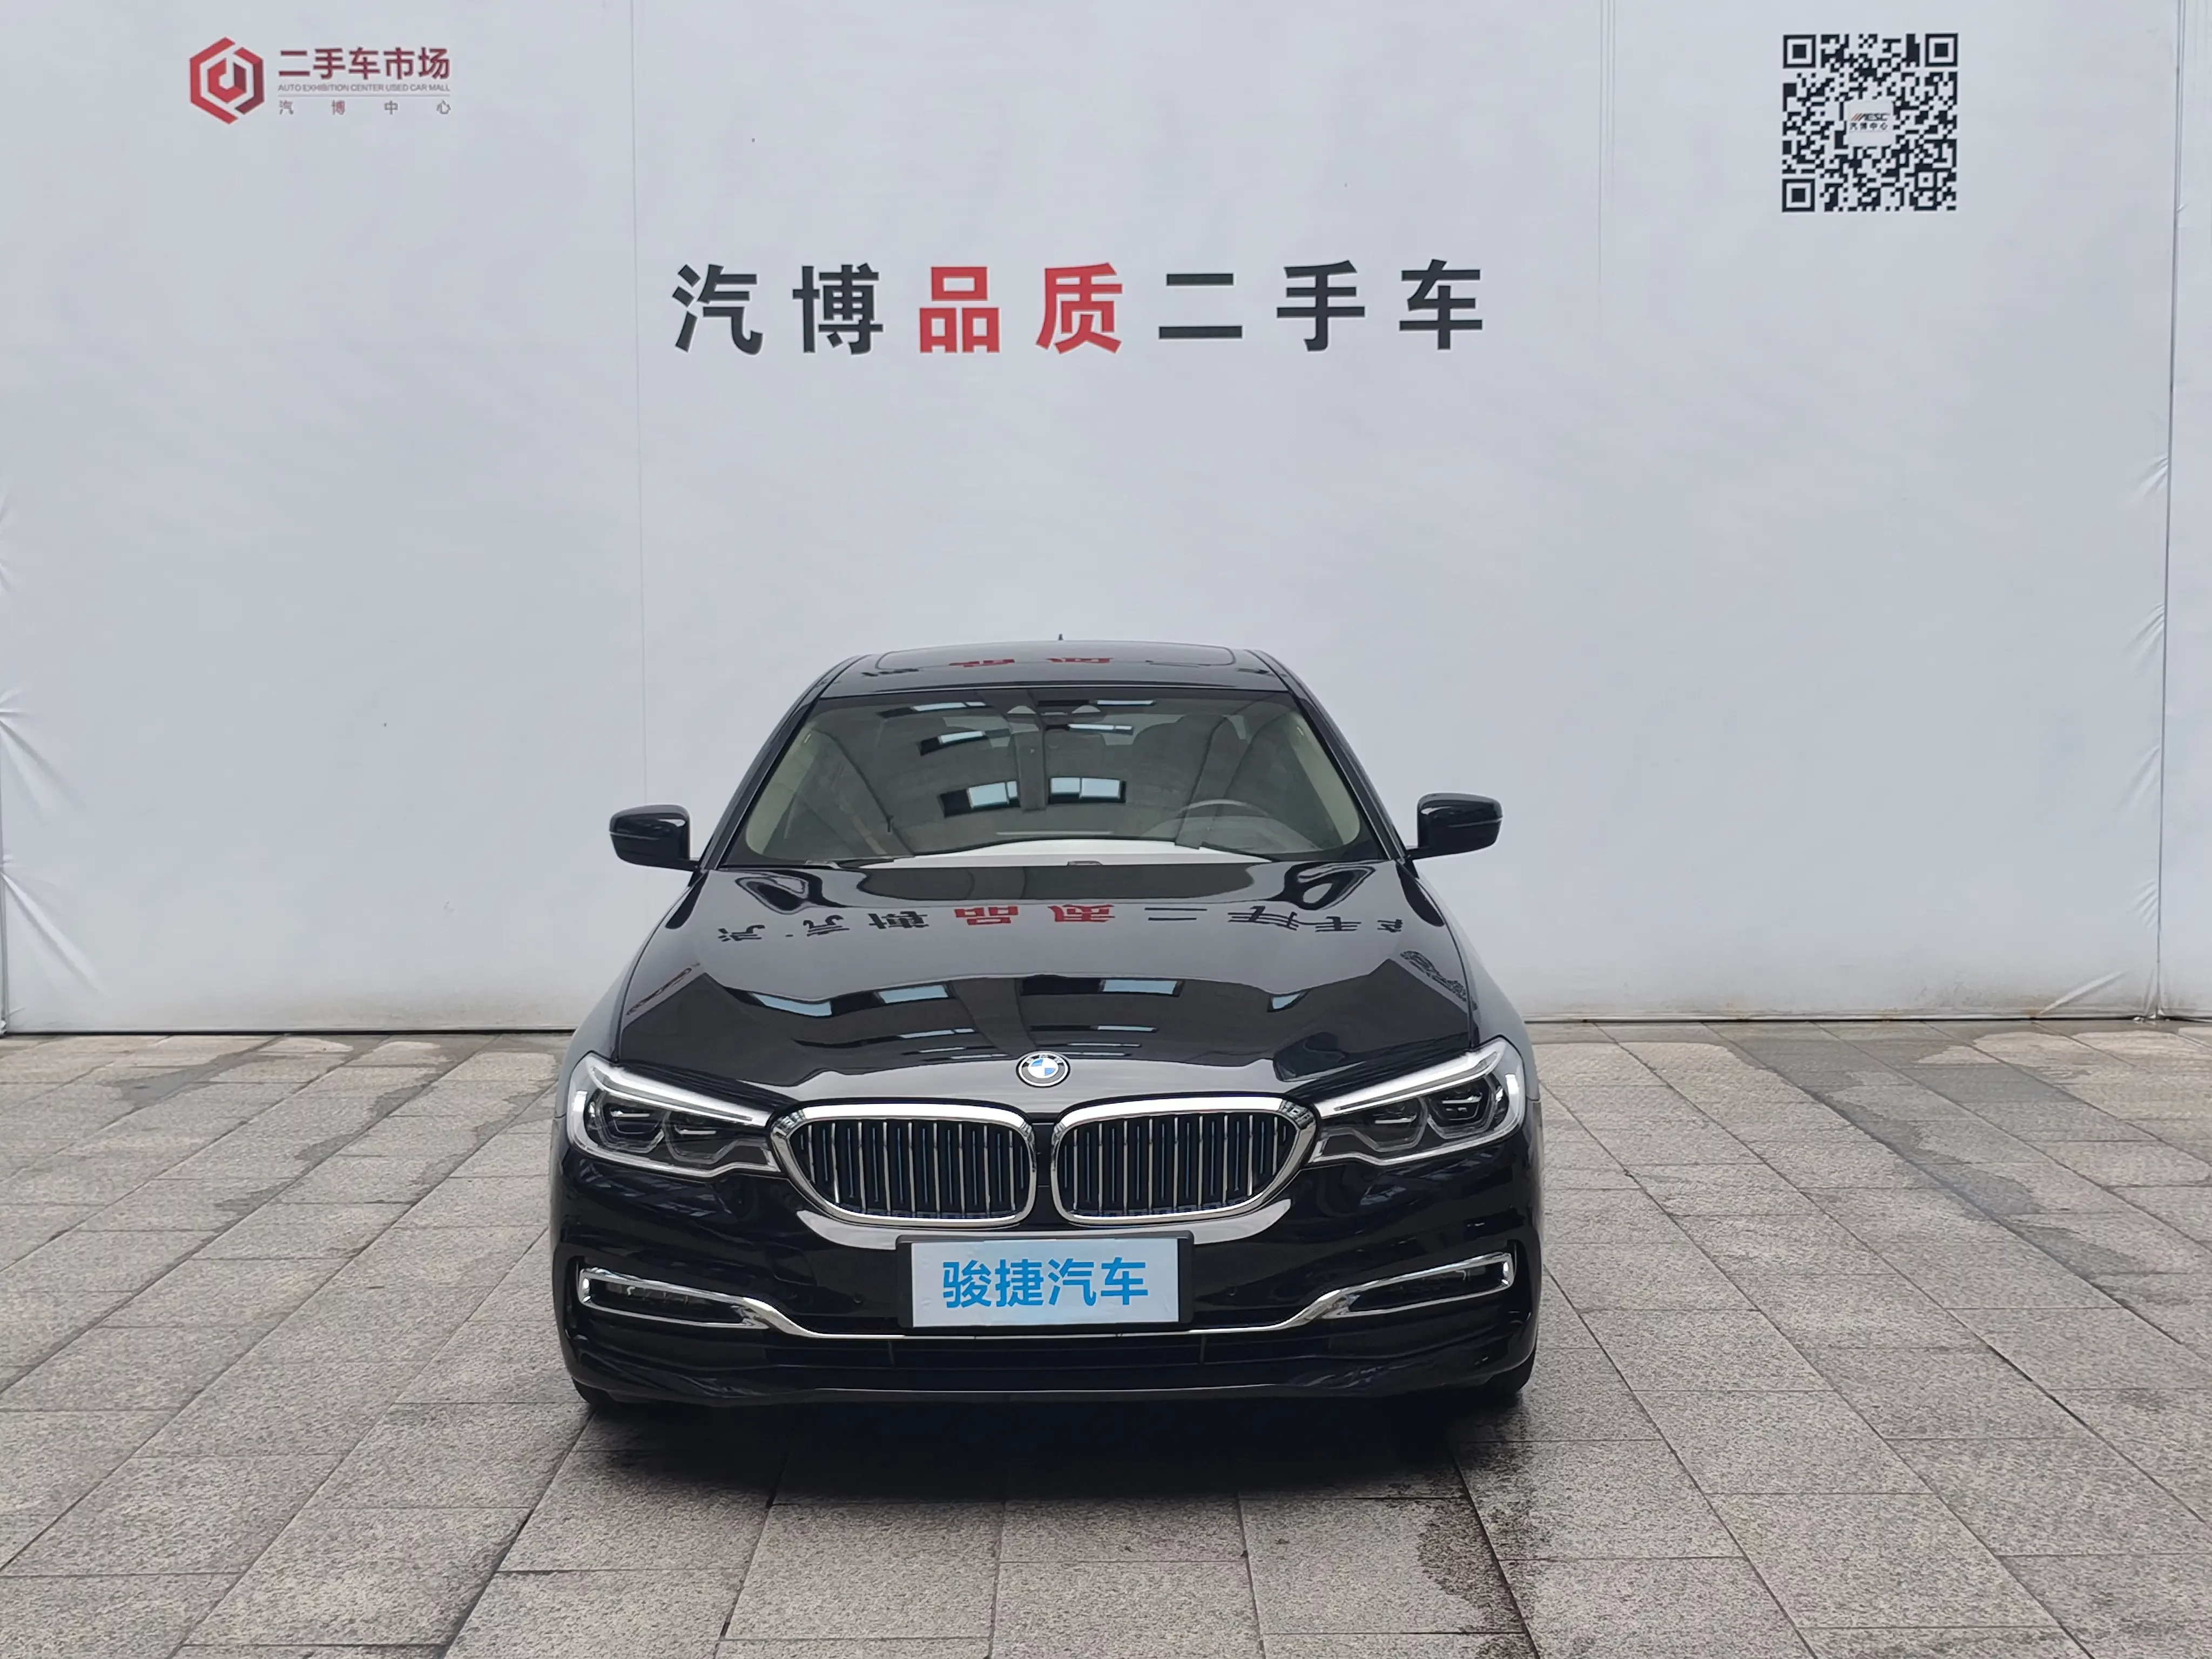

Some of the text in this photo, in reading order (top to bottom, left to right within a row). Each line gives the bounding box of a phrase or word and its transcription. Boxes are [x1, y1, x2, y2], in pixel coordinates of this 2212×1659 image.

[278, 46, 450, 80] 二手车市场
[671, 259, 1483, 355] 汽博品质二手车
[943, 1257, 1148, 1309] 骏捷汽车
